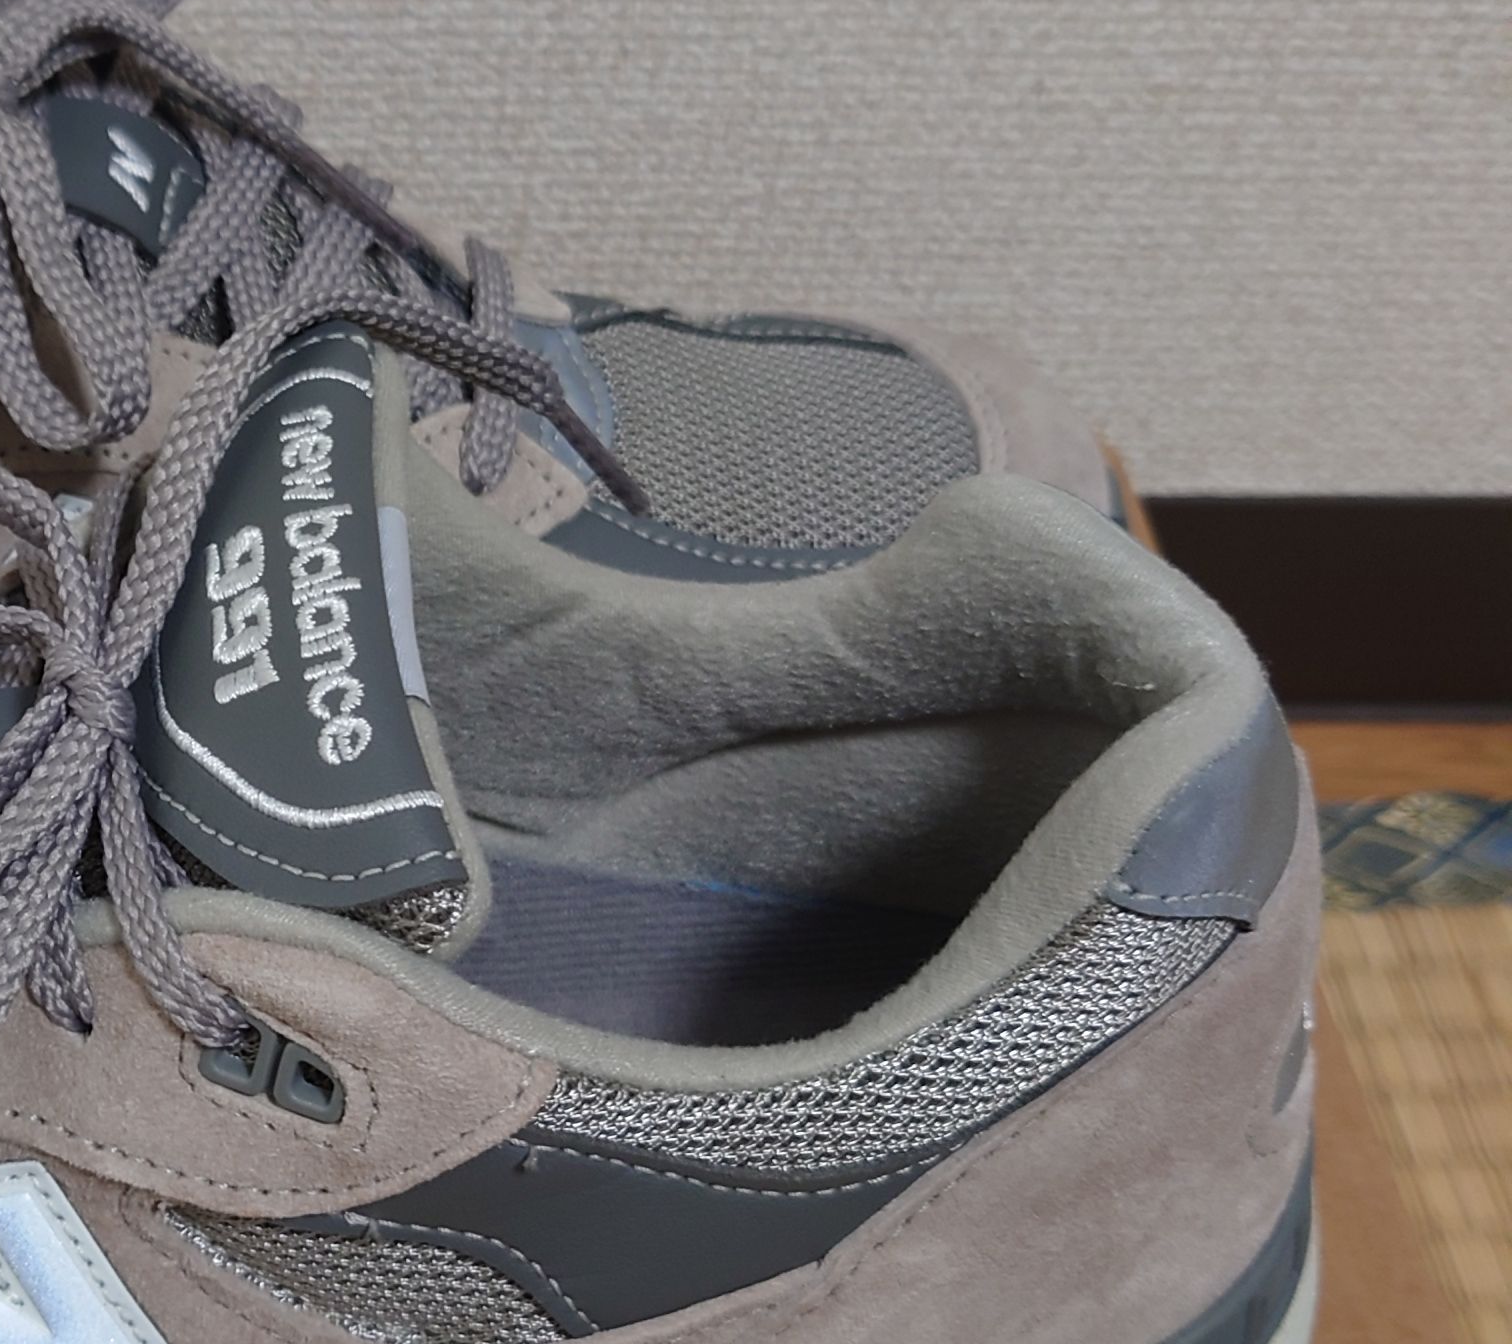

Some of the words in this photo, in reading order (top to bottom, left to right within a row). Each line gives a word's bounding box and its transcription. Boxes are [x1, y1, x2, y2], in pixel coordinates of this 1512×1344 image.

[279, 404, 335, 501] new
[205, 526, 280, 704] 991
[284, 503, 373, 766] balance
